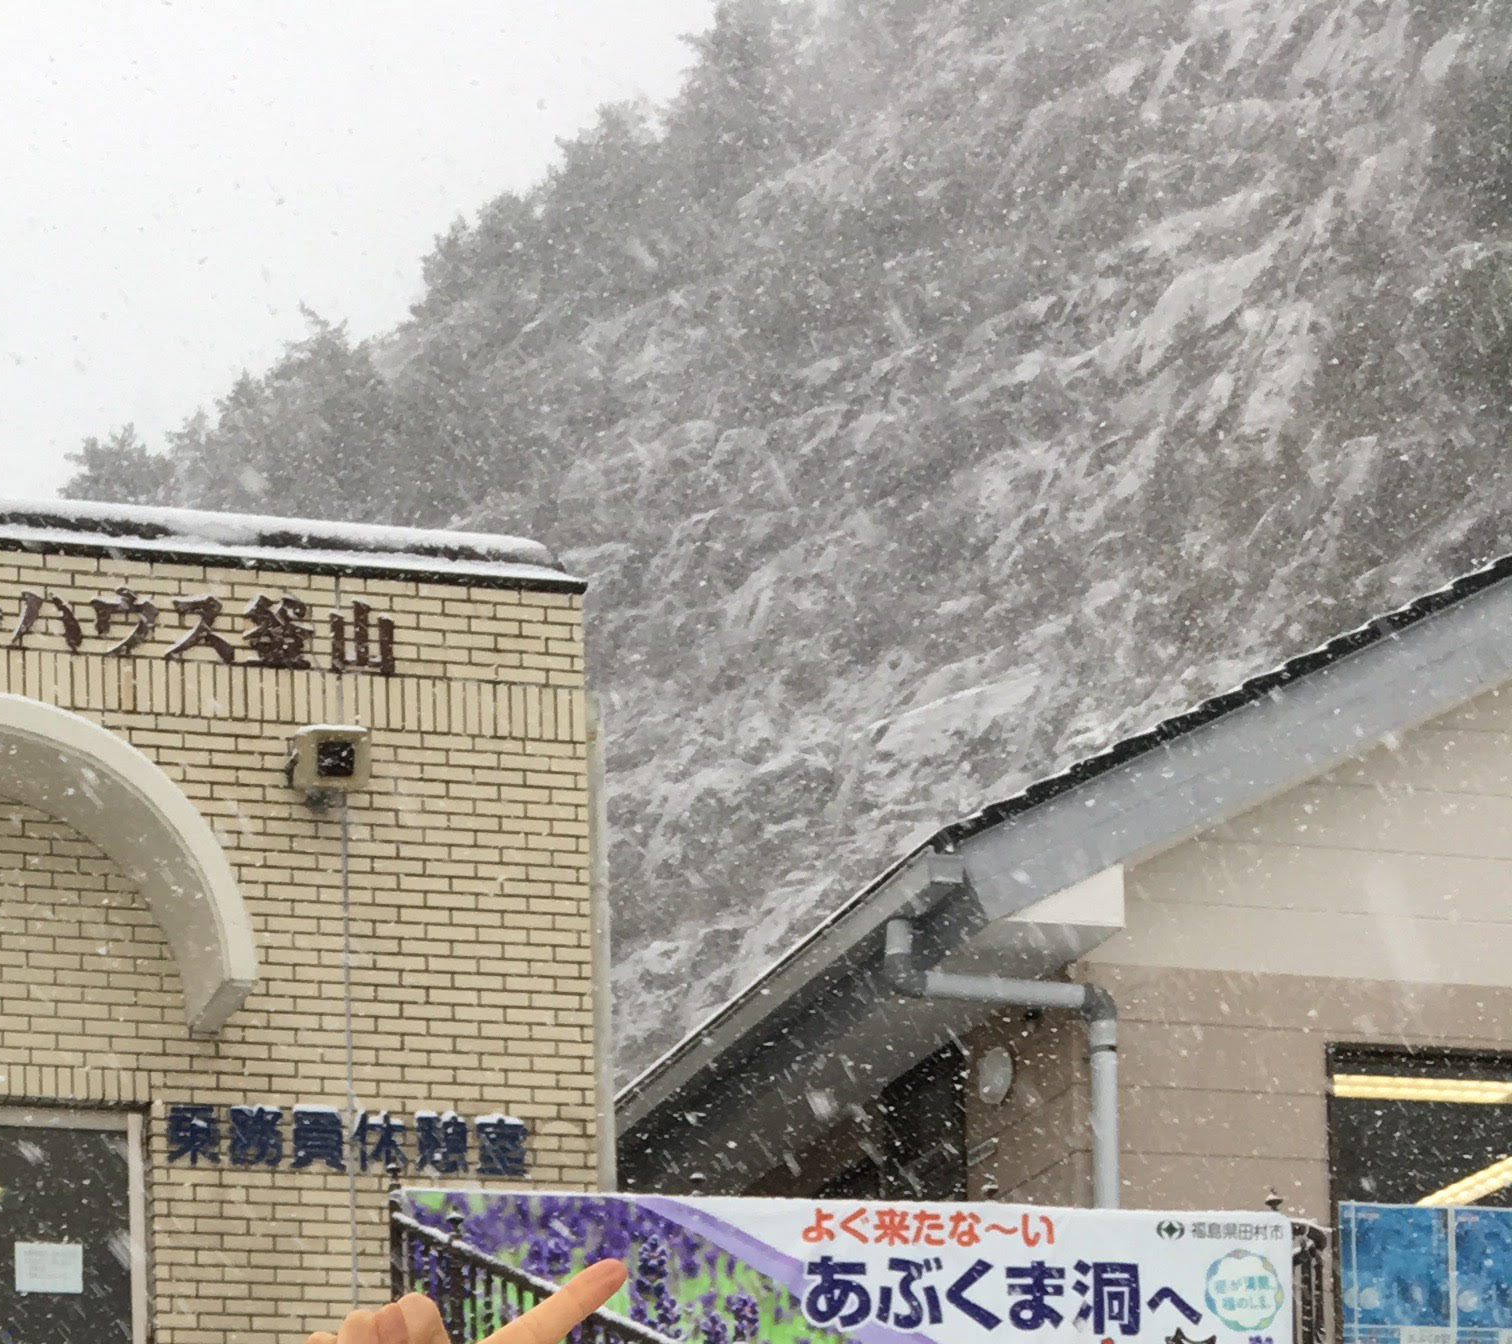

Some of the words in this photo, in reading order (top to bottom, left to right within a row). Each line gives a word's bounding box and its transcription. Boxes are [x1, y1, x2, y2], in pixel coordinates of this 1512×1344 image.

[167, 1101, 530, 1176] 乗務員休憩室
[1191, 1221, 1284, 1241] 福島県田村市
[805, 1254, 1203, 1336] あぶくま洞へ
